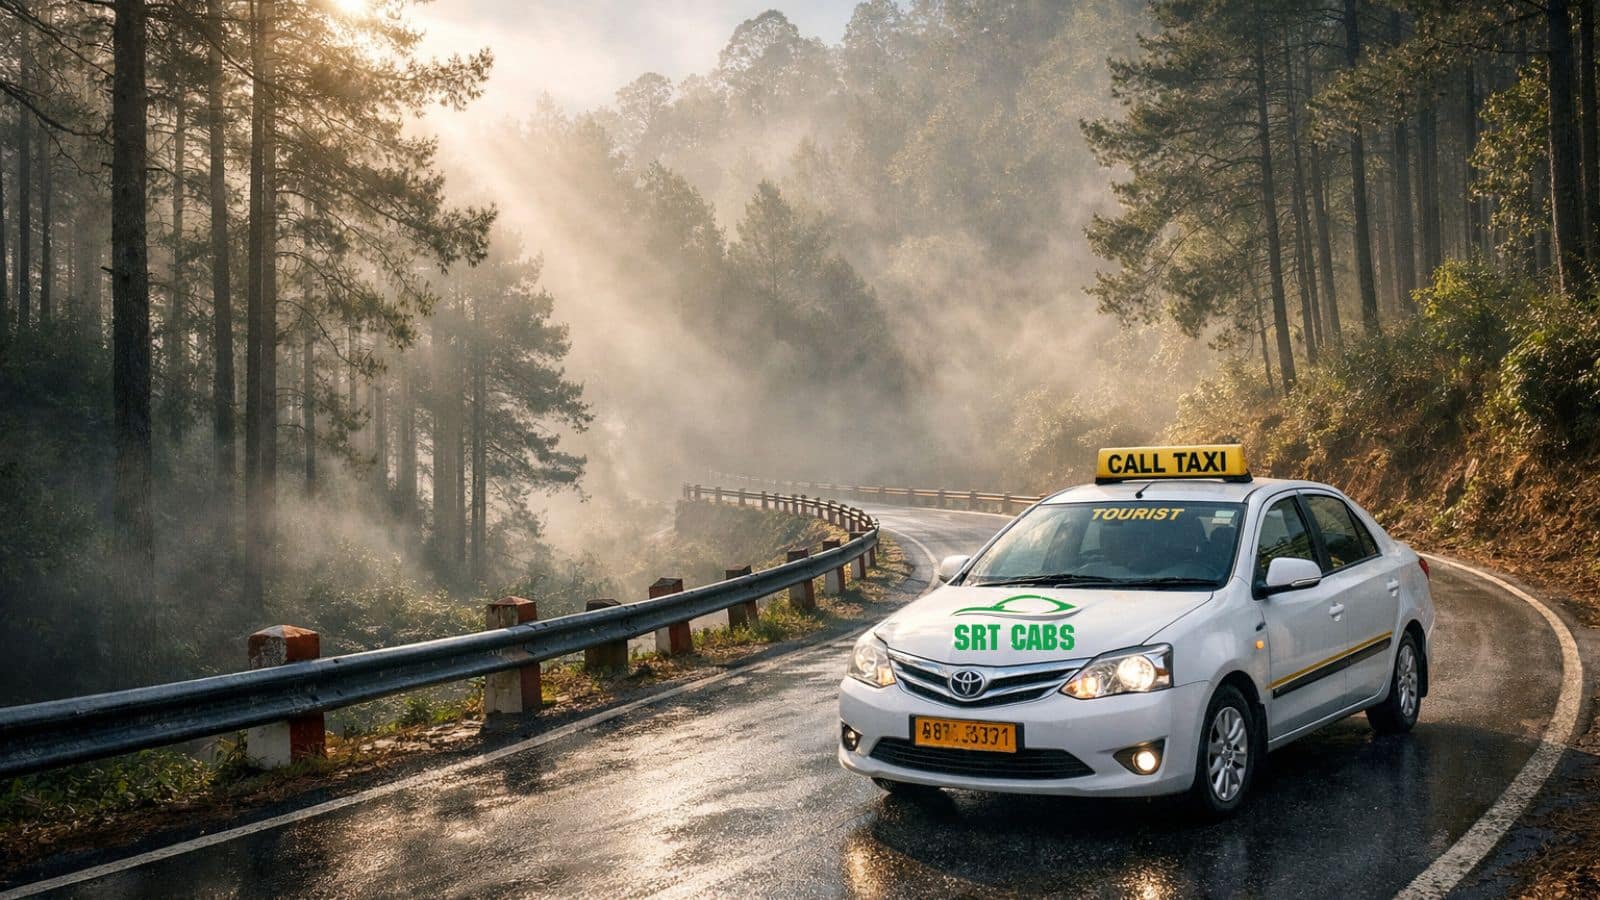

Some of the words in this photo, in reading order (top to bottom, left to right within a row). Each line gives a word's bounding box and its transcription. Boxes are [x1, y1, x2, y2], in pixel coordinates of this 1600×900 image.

[1108, 453, 1166, 474] CALL
[1173, 451, 1226, 473] TAXI
[1092, 508, 1184, 521] TOURIST
[954, 624, 1000, 650] SRT
[1011, 624, 1075, 650] CABS
